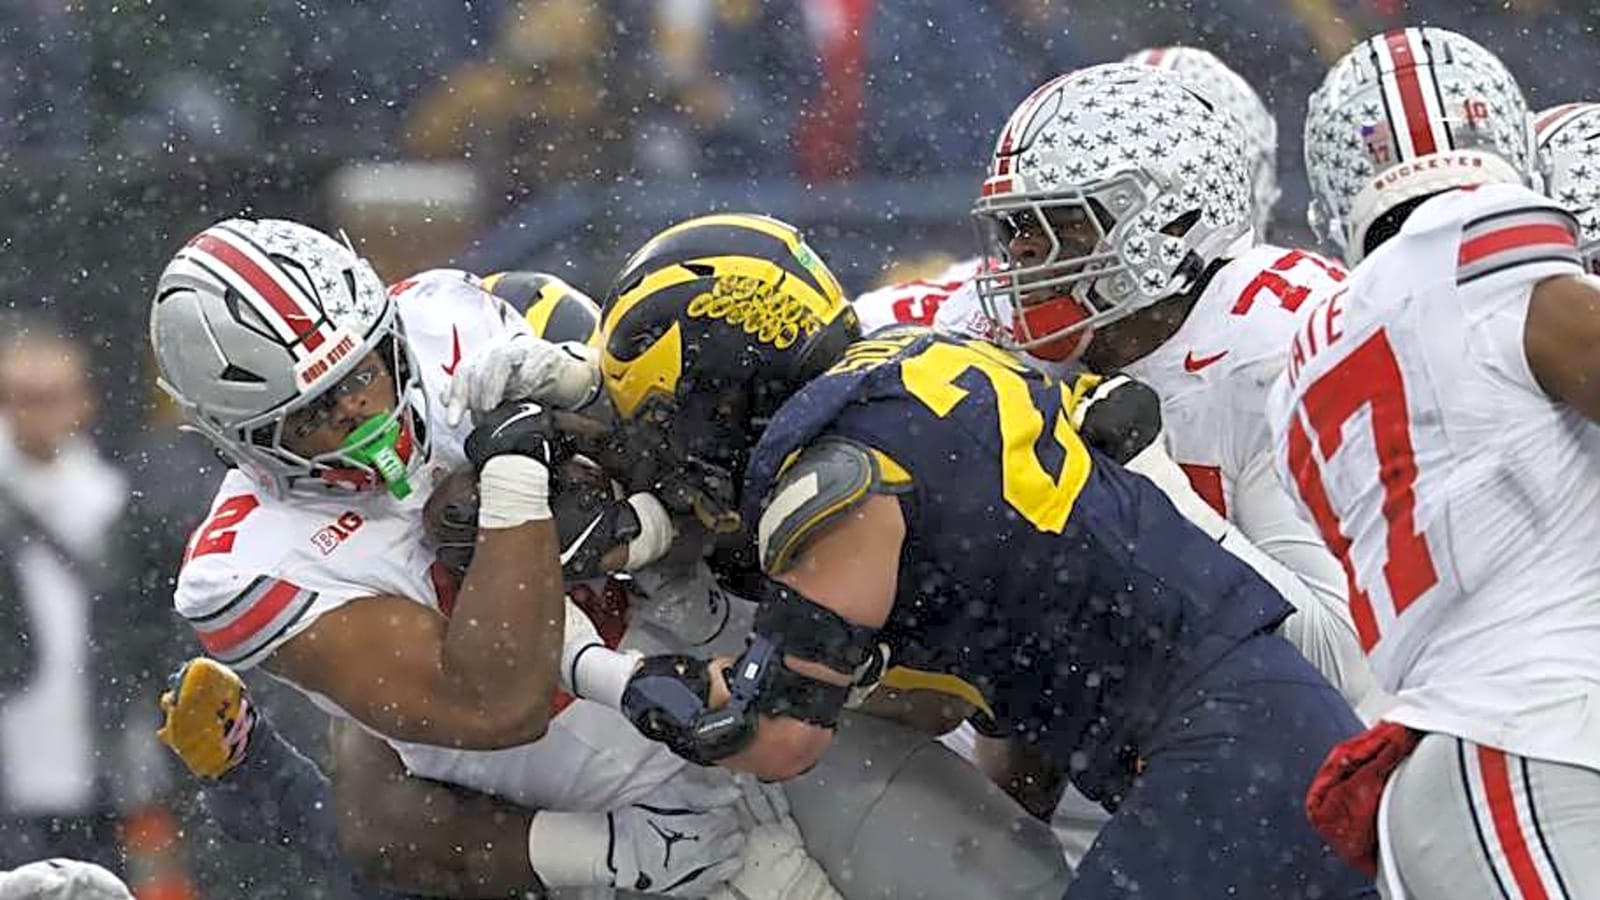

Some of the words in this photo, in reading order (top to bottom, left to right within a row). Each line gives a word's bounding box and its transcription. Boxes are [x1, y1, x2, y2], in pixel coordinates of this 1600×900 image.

[1374, 156, 1483, 190] BUCKEYES
[302, 360, 328, 384] OHIO
[327, 334, 355, 365] STATE
[1287, 326, 1439, 656] 17
